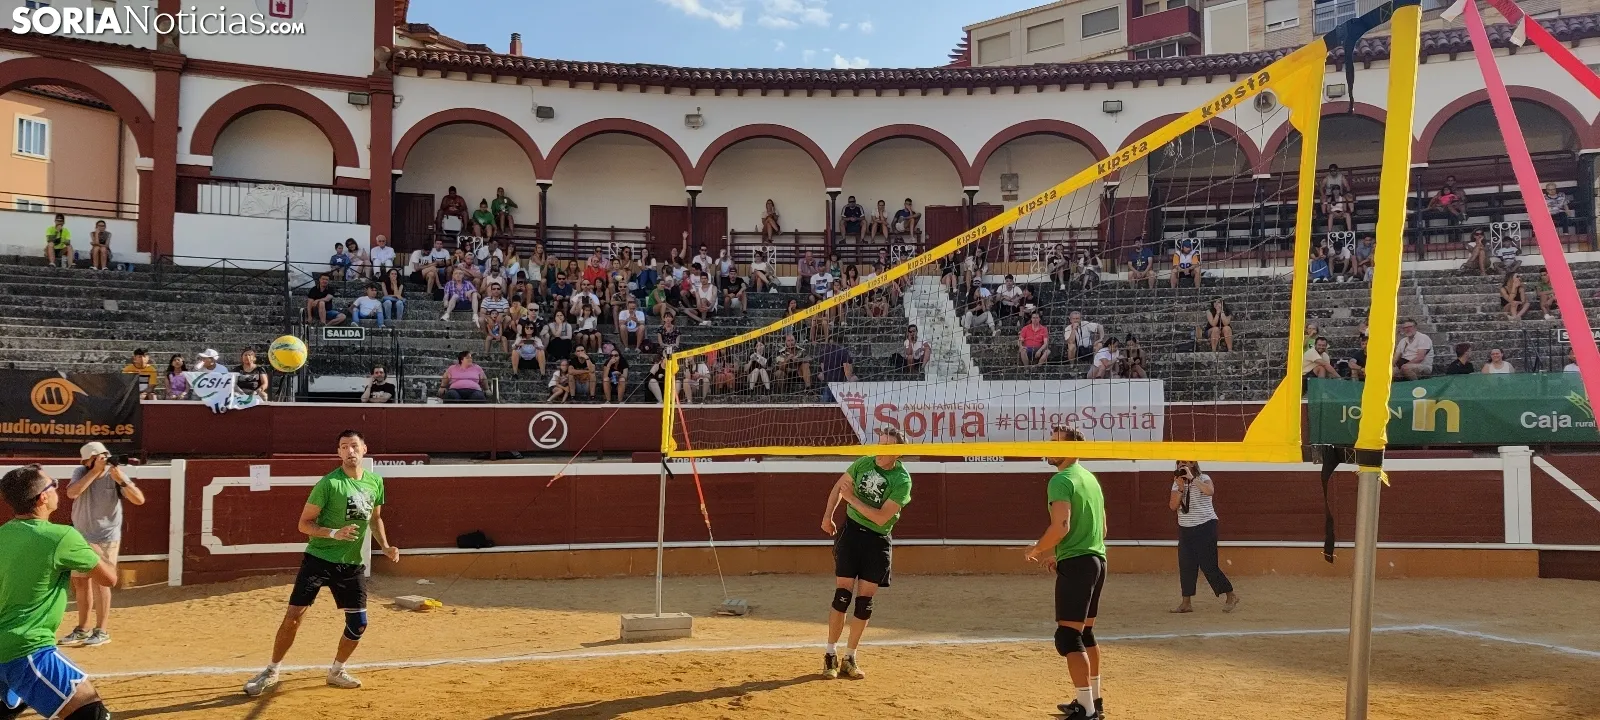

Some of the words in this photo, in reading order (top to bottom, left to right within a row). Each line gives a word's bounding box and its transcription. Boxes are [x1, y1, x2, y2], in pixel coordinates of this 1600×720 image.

[326, 329, 361, 337] SALIDA
[903, 402, 985, 410] AYUNTAMIENTO
[1412, 386, 1460, 433] in
[0, 418, 134, 436] udiovisuales.es
[540, 415, 557, 443] 2
[873, 403, 985, 438] Soria
[995, 406, 1157, 436] #eligeSoria
[1520, 410, 1573, 433] Caja
